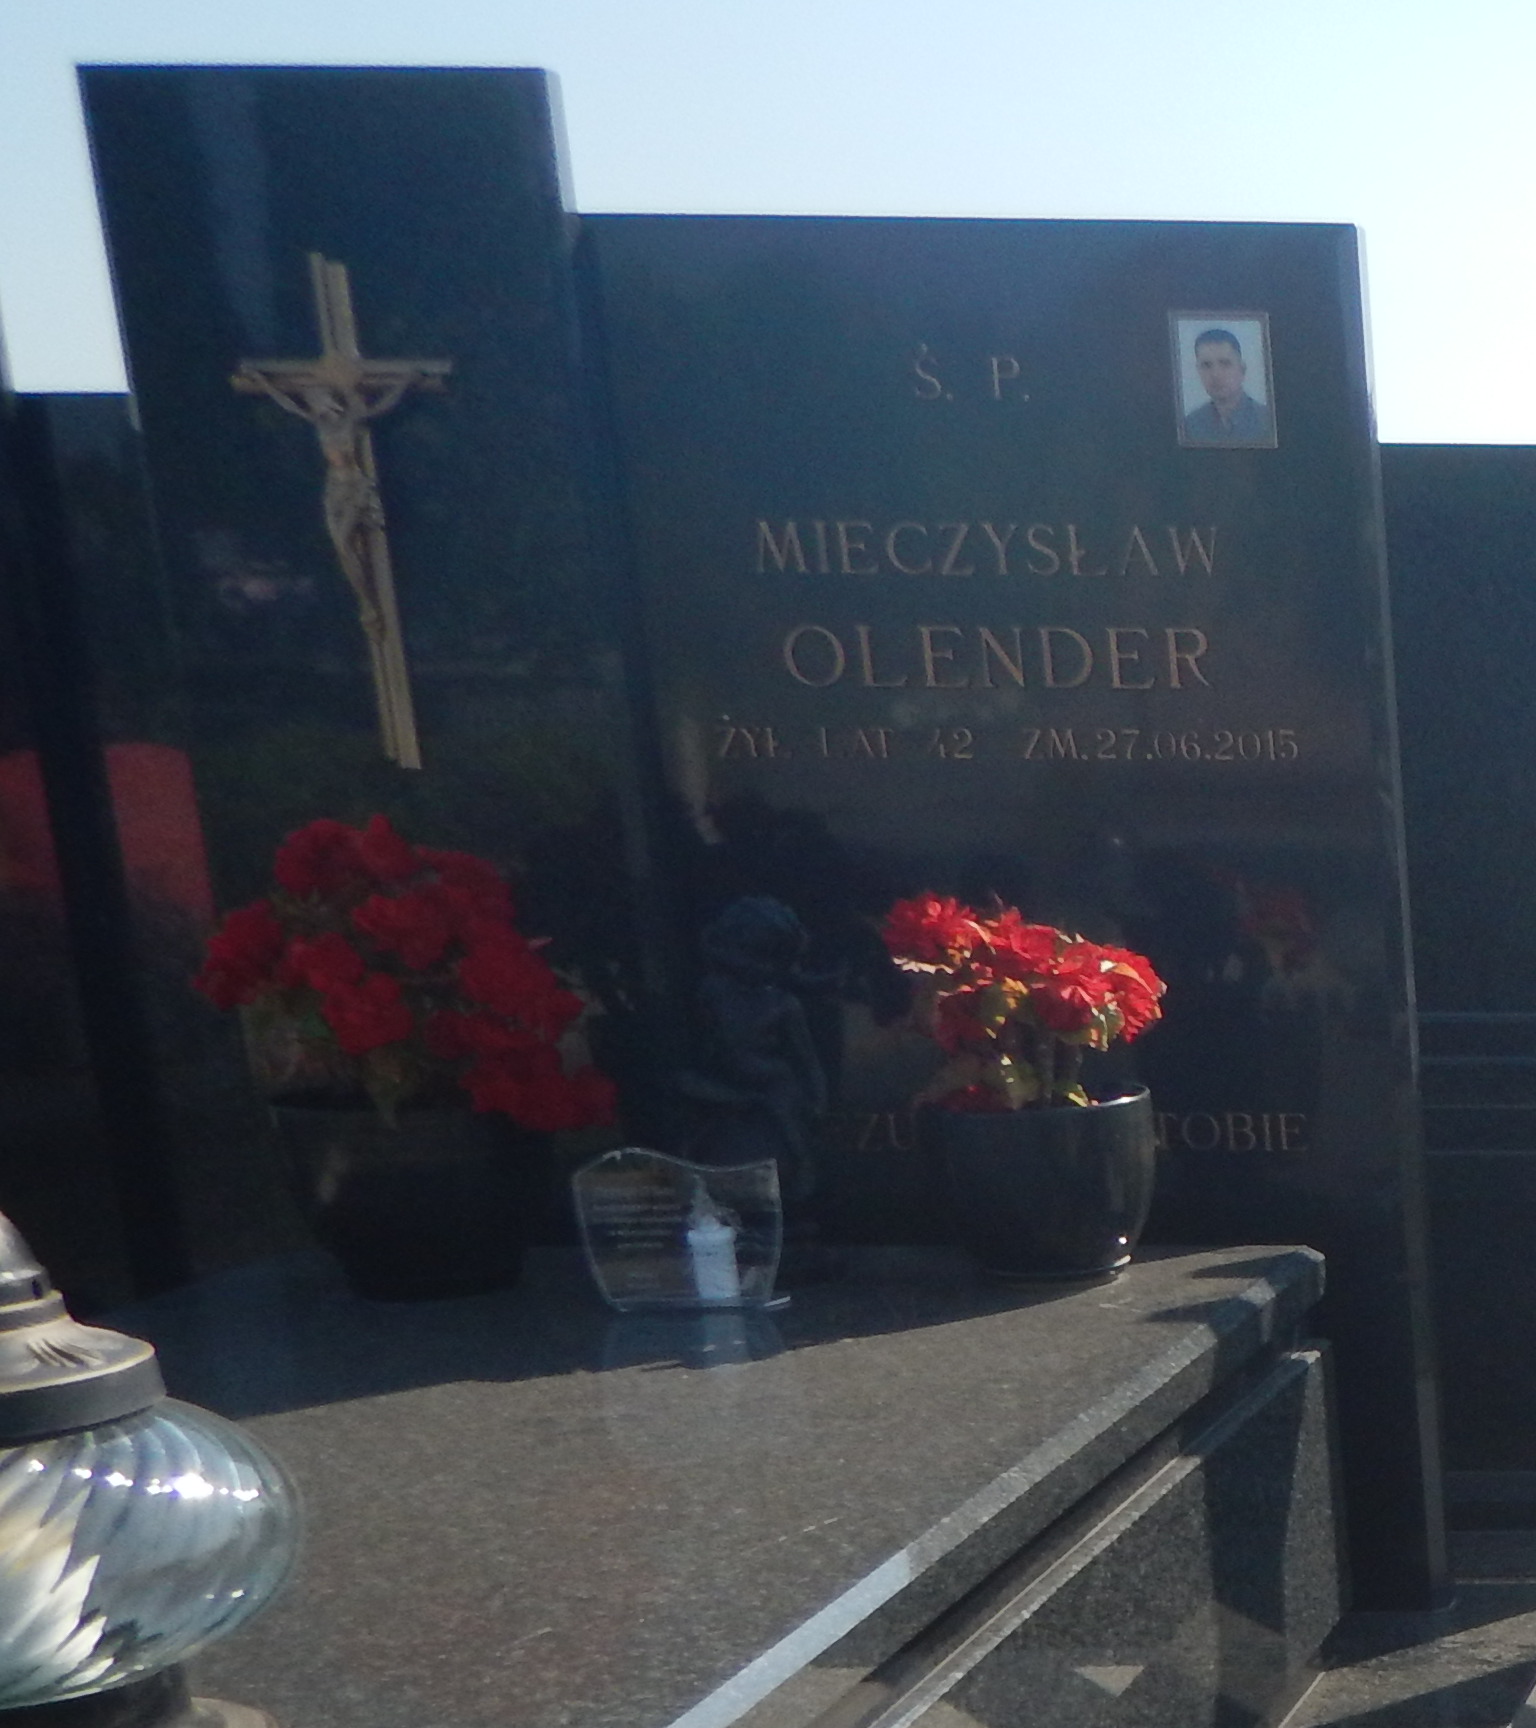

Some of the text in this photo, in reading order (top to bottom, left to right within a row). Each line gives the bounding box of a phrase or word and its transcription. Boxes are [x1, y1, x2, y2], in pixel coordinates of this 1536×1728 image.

[990, 355, 1031, 403] P.
[755, 519, 1219, 578] MIECZYSŁAW
[782, 624, 1211, 690] OLENDER
